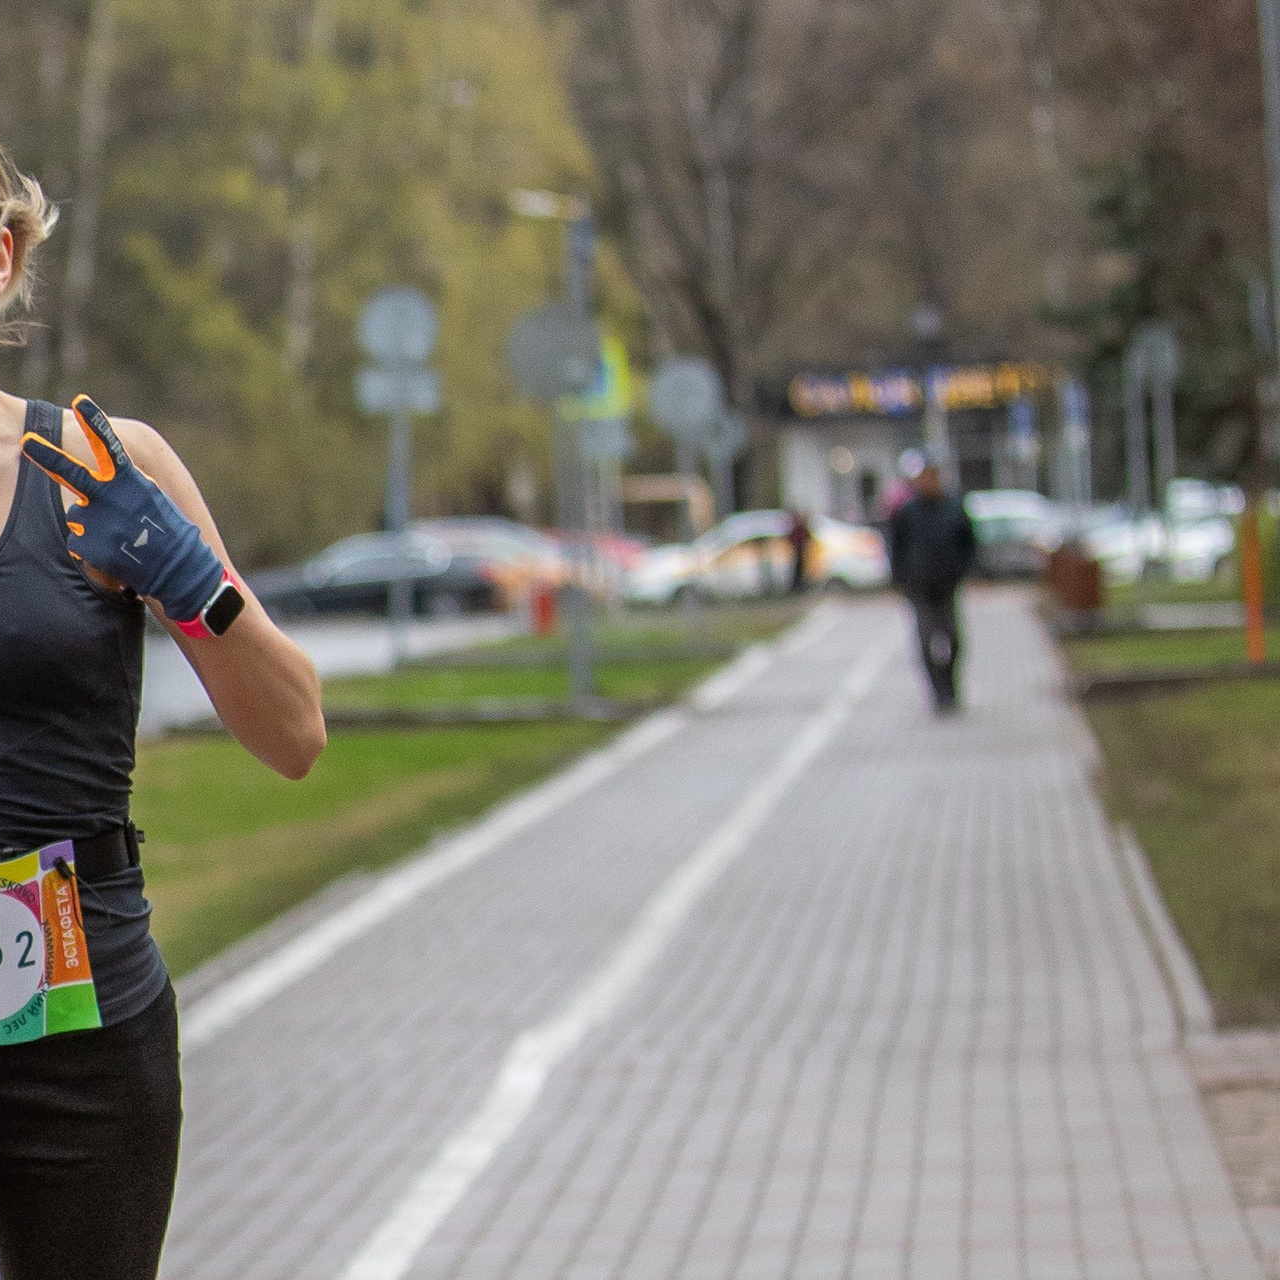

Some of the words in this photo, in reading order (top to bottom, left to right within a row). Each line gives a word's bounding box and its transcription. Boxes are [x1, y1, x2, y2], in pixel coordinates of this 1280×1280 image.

[91, 412, 125, 465] RUNNING
[15, 930, 36, 969] 2
[56, 885, 80, 969] ЭСТАФЕТА
[2, 1014, 27, 1036] ЛЕС
